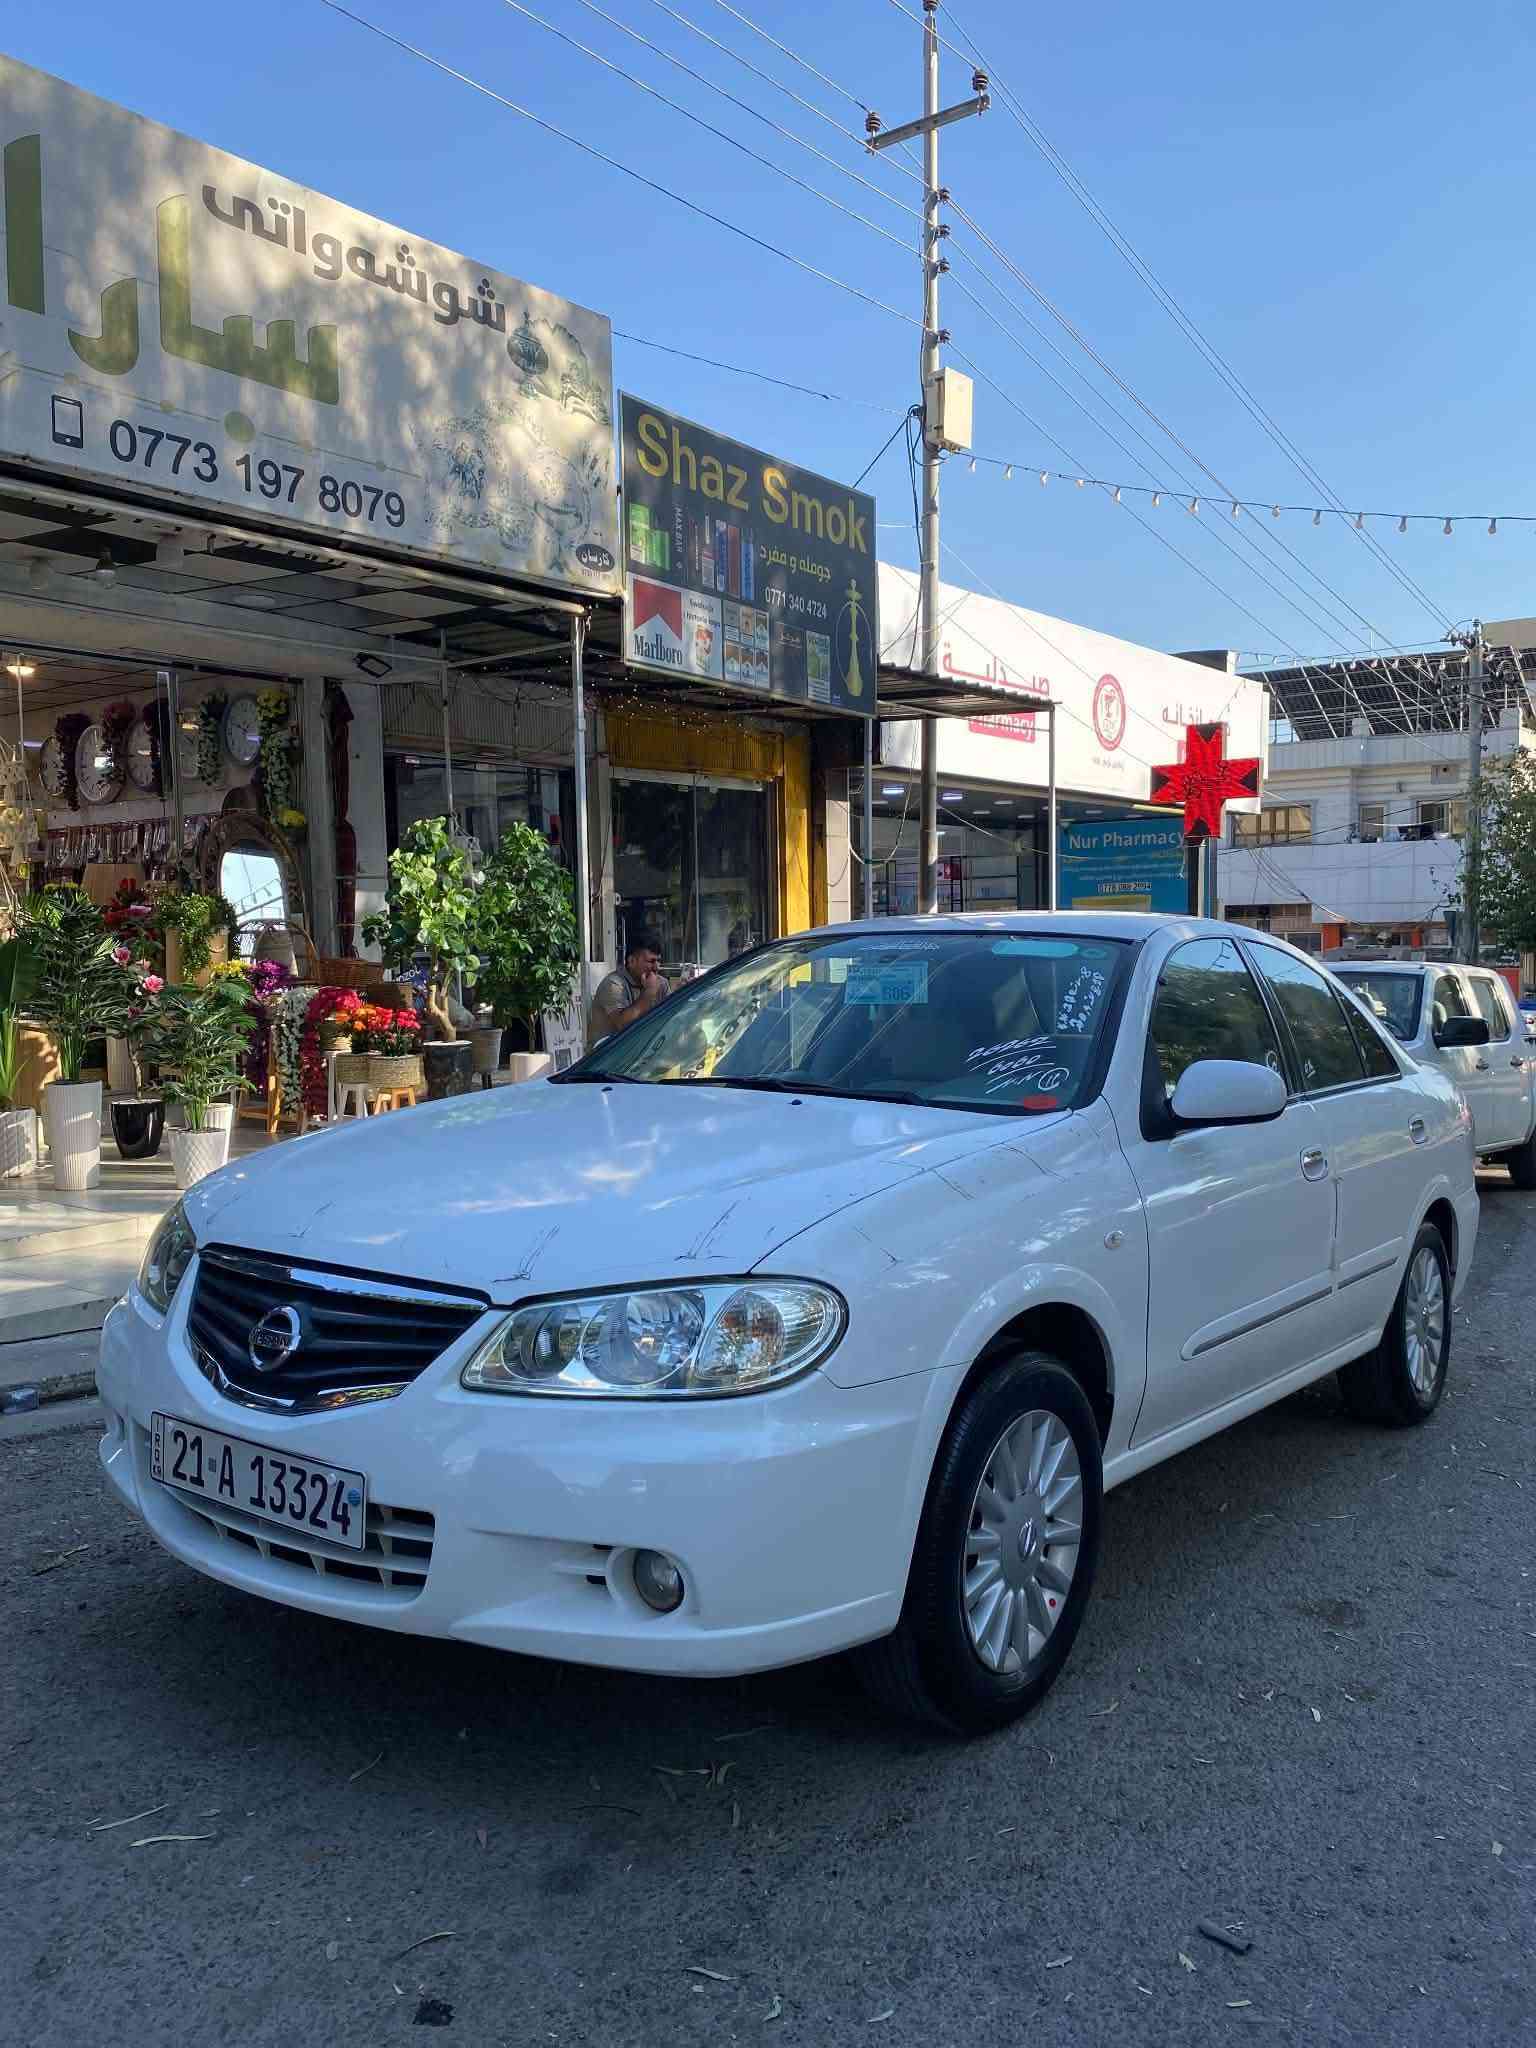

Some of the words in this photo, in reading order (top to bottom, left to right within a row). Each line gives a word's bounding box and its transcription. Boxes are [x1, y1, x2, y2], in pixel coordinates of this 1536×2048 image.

[109, 419, 219, 483] 0773
[236, 454, 305, 503] 197
[319, 475, 406, 528] 8079
[637, 414, 749, 510] Shaz
[761, 467, 866, 554] Smok
[765, 587, 786, 607] 0771
[806, 600, 827, 619] 4724
[633, 634, 683, 664] Marlboro
[1069, 834, 1099, 849] Nur
[1103, 831, 1185, 849] Pharmacy
[172, 1430, 204, 1487] 21
[218, 1445, 235, 1498] A
[249, 1455, 350, 1536] 13324
